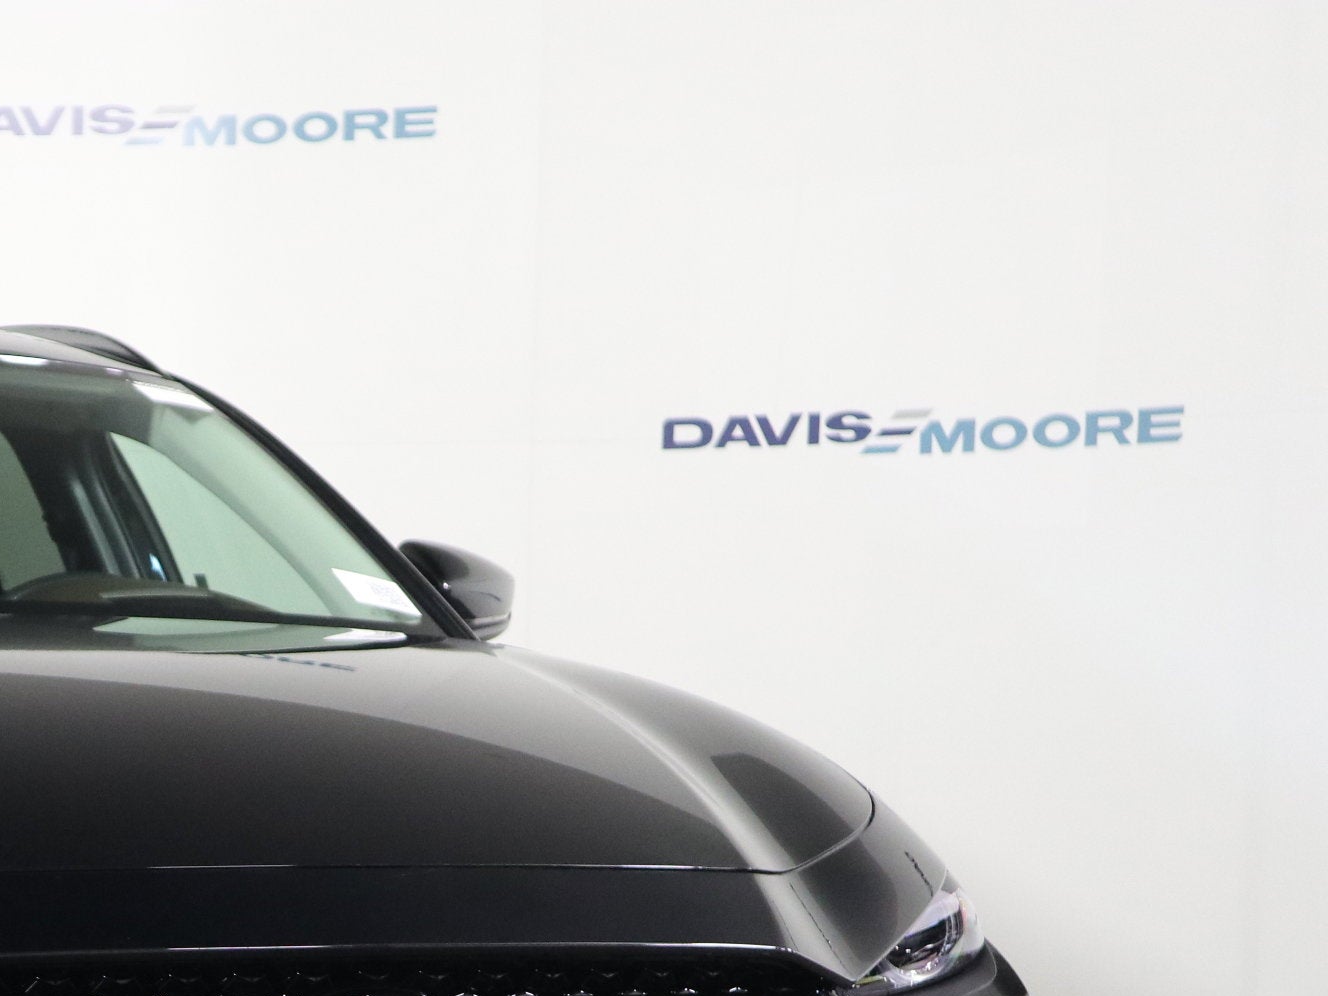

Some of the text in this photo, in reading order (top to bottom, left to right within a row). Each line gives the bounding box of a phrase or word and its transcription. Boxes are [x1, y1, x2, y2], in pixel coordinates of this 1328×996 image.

[182, 104, 439, 147] MOORE
[661, 405, 1185, 455] DAVIS MOORE
